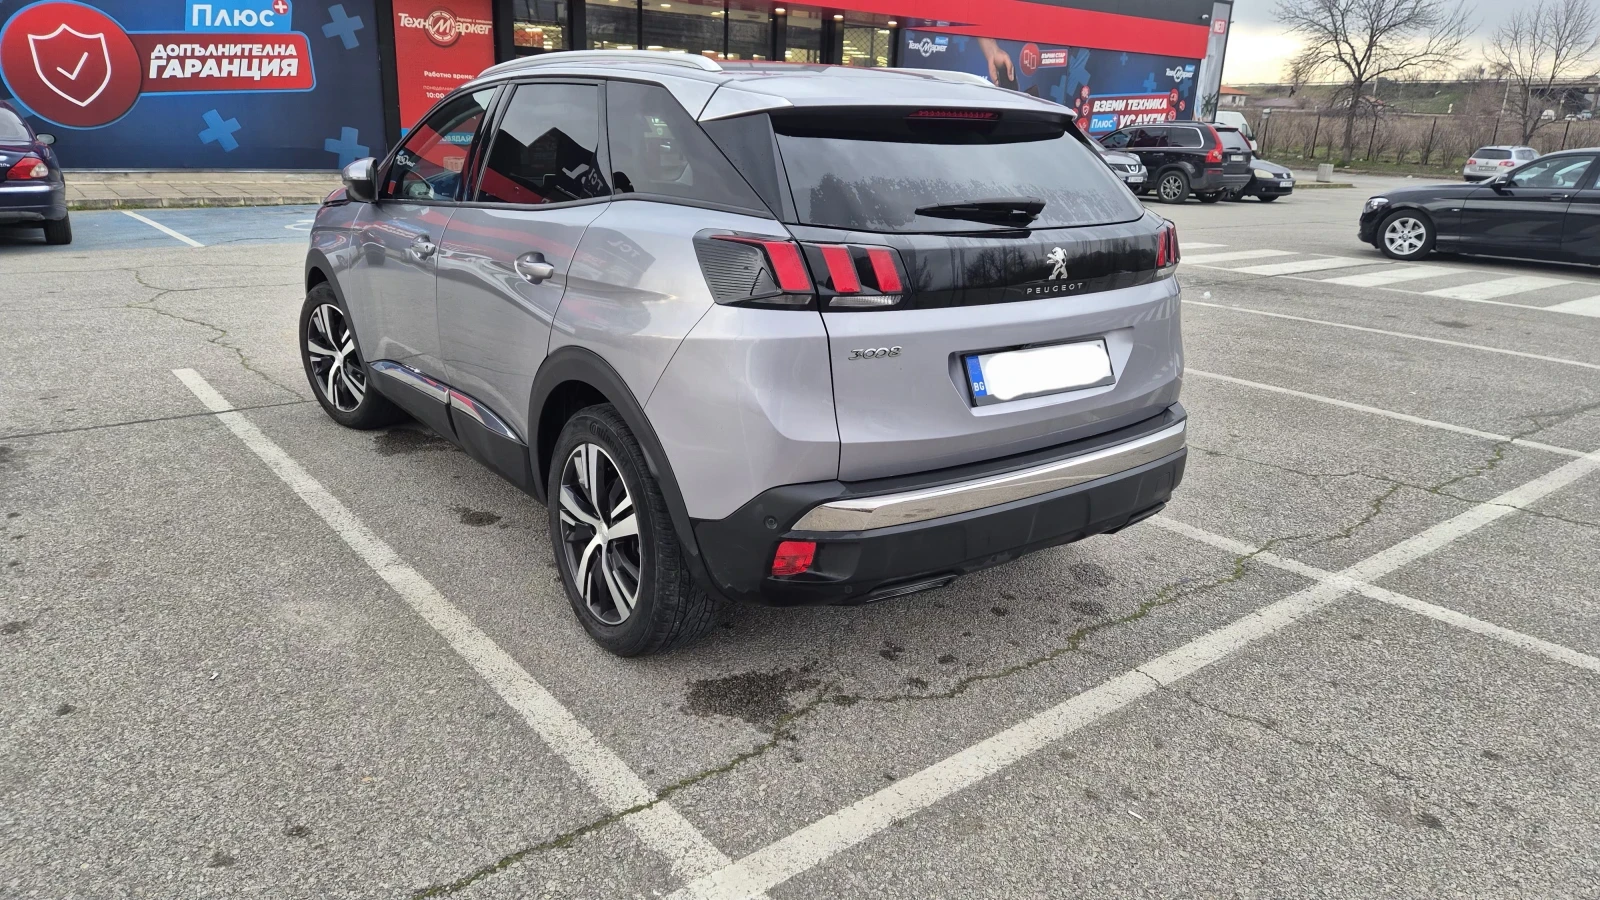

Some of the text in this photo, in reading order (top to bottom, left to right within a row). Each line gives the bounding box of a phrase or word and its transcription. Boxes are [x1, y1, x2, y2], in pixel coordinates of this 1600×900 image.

[151, 44, 297, 59] ДОПЪЛНИТЕЛНА
[149, 58, 299, 80] ГАРАНЦИЯ
[423, 70, 452, 79] Работно
[1093, 98, 1168, 112] ВЗЕМИ ТЕХНИКА
[1026, 283, 1083, 294] PEUGEOT
[848, 346, 902, 360] 3008
[973, 381, 985, 391] BG
